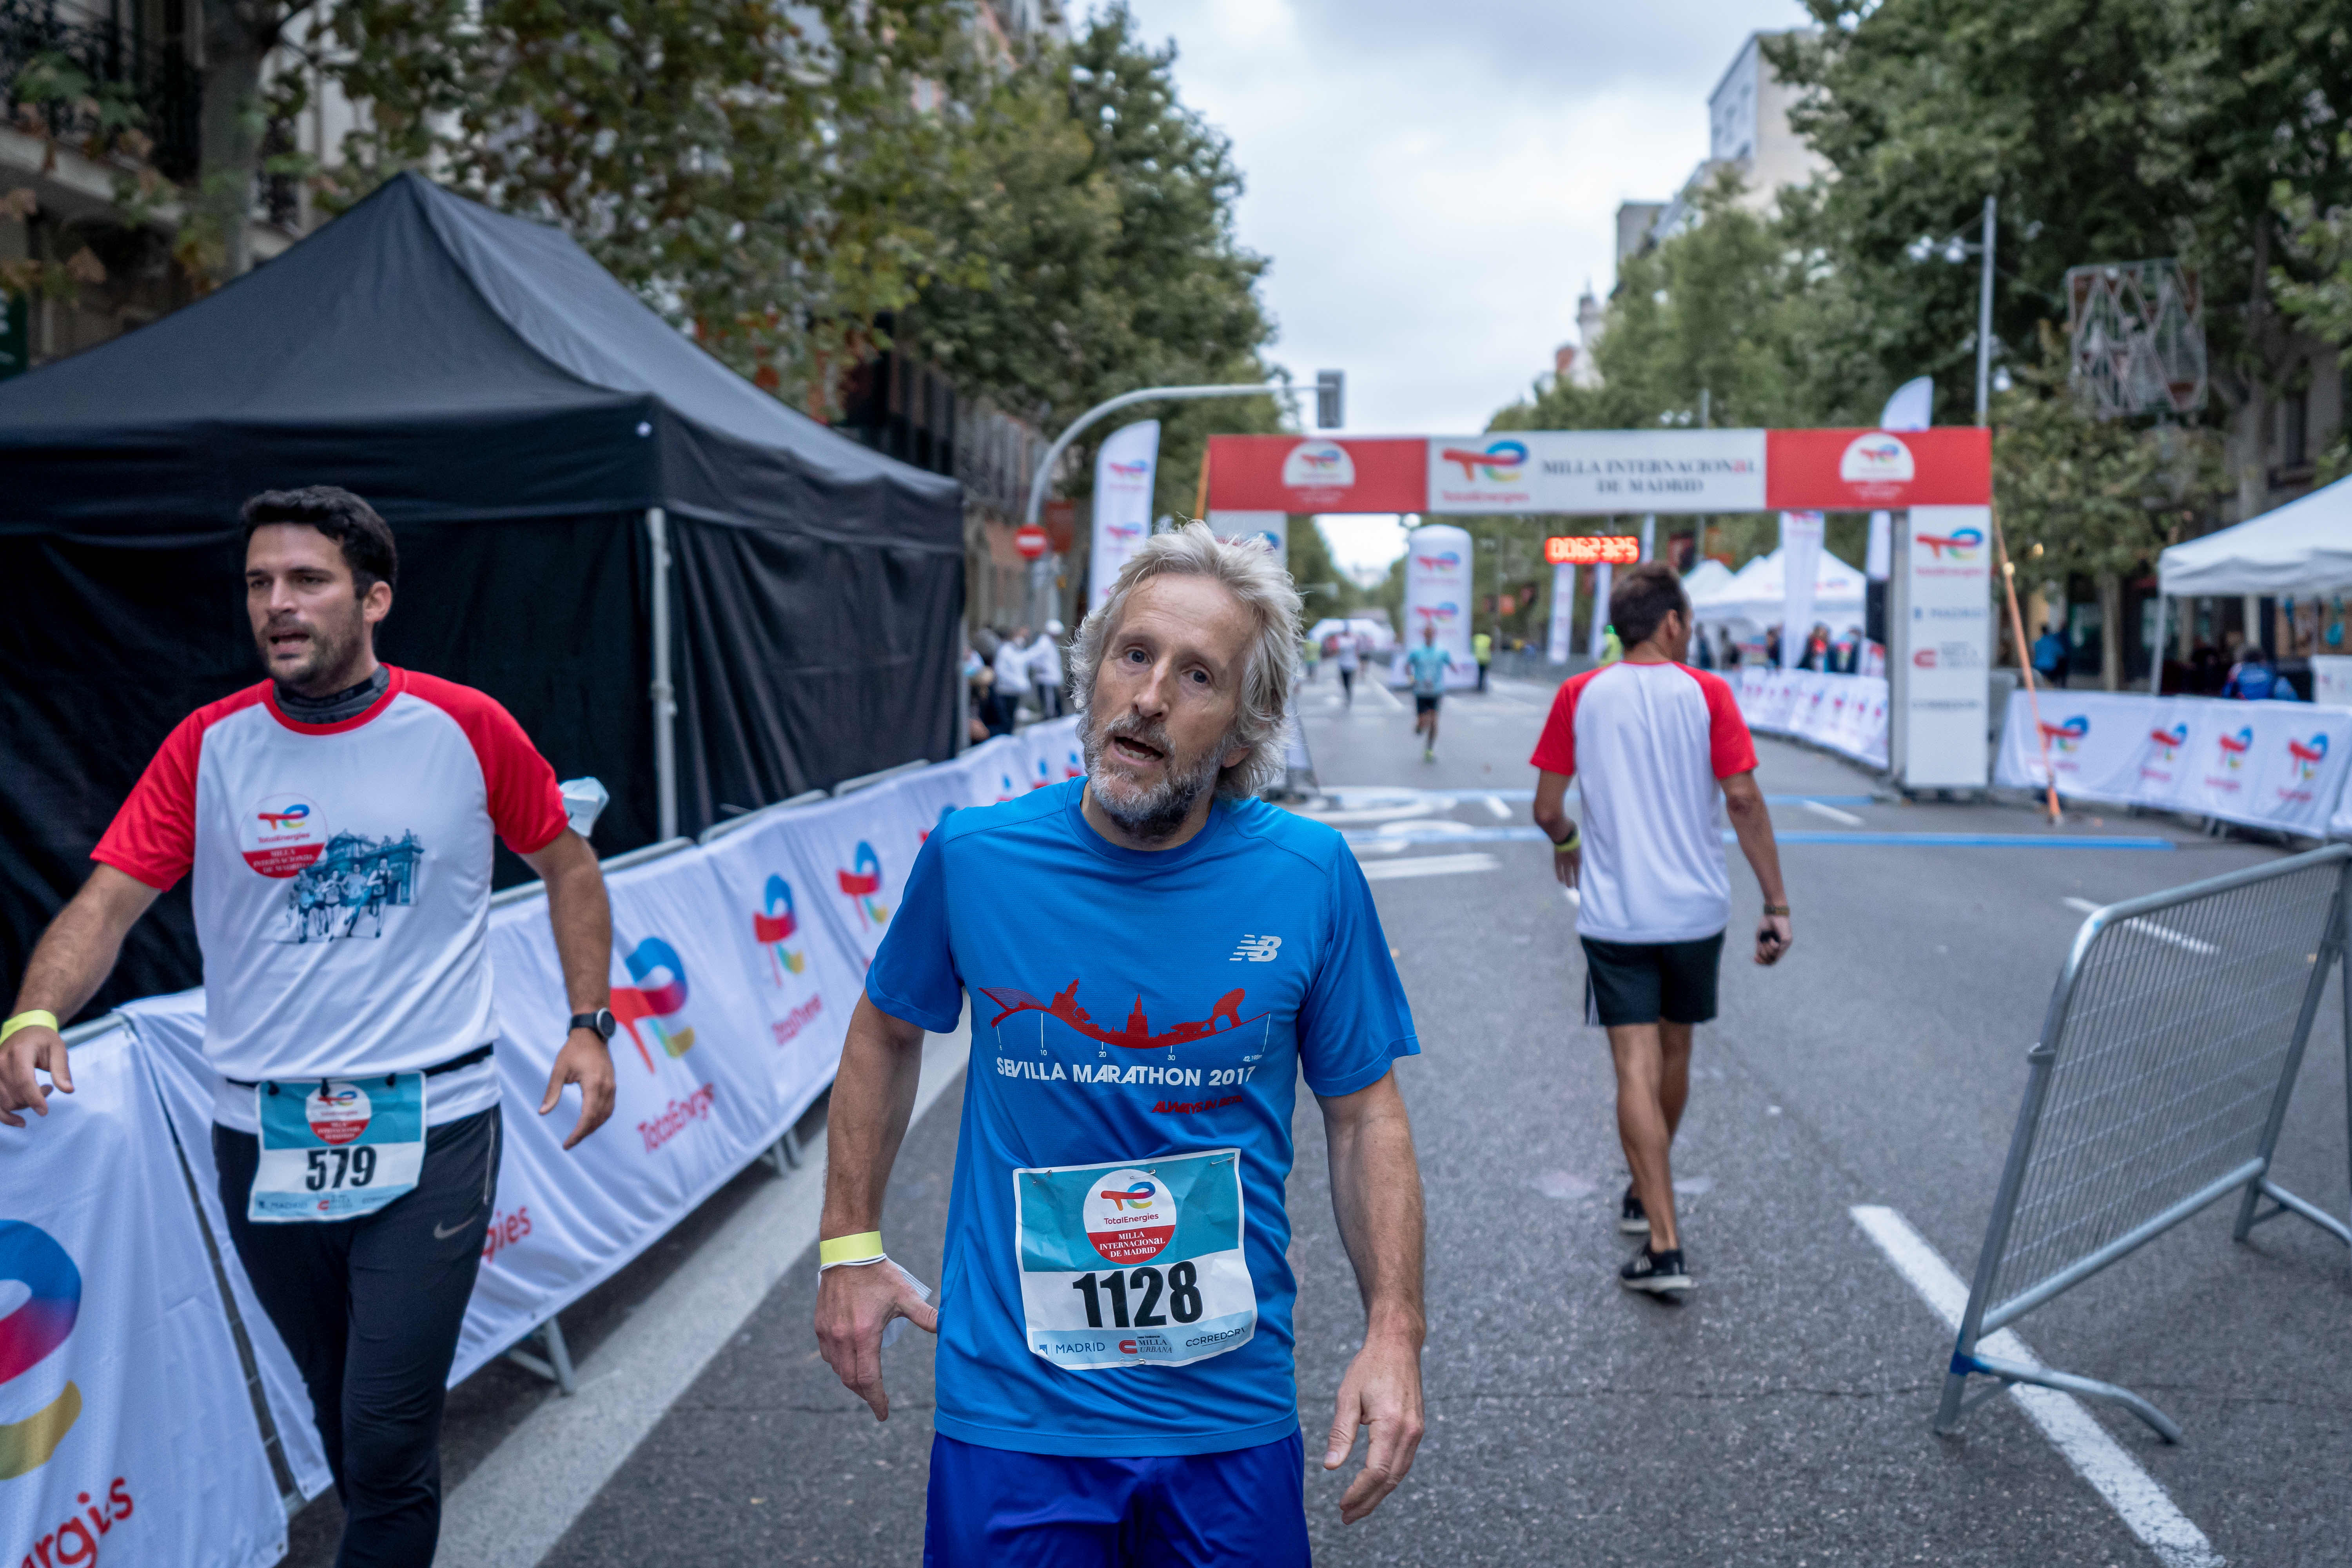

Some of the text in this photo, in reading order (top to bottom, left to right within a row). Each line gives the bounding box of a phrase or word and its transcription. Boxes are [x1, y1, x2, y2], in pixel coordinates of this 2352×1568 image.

[996, 1057, 1256, 1087] SEVILLA MARATHON 2017
[1152, 1100, 1203, 1114] ALWAYS
[1204, 1099, 1217, 1110] IN
[305, 1145, 376, 1191] 579
[1104, 1213, 1159, 1225] TotalEnergies
[1118, 1231, 1145, 1240] MILLA
[1123, 1247, 1156, 1256] MADRID
[1072, 1260, 1203, 1328] 1128
[1056, 1341, 1105, 1354] MADRID
